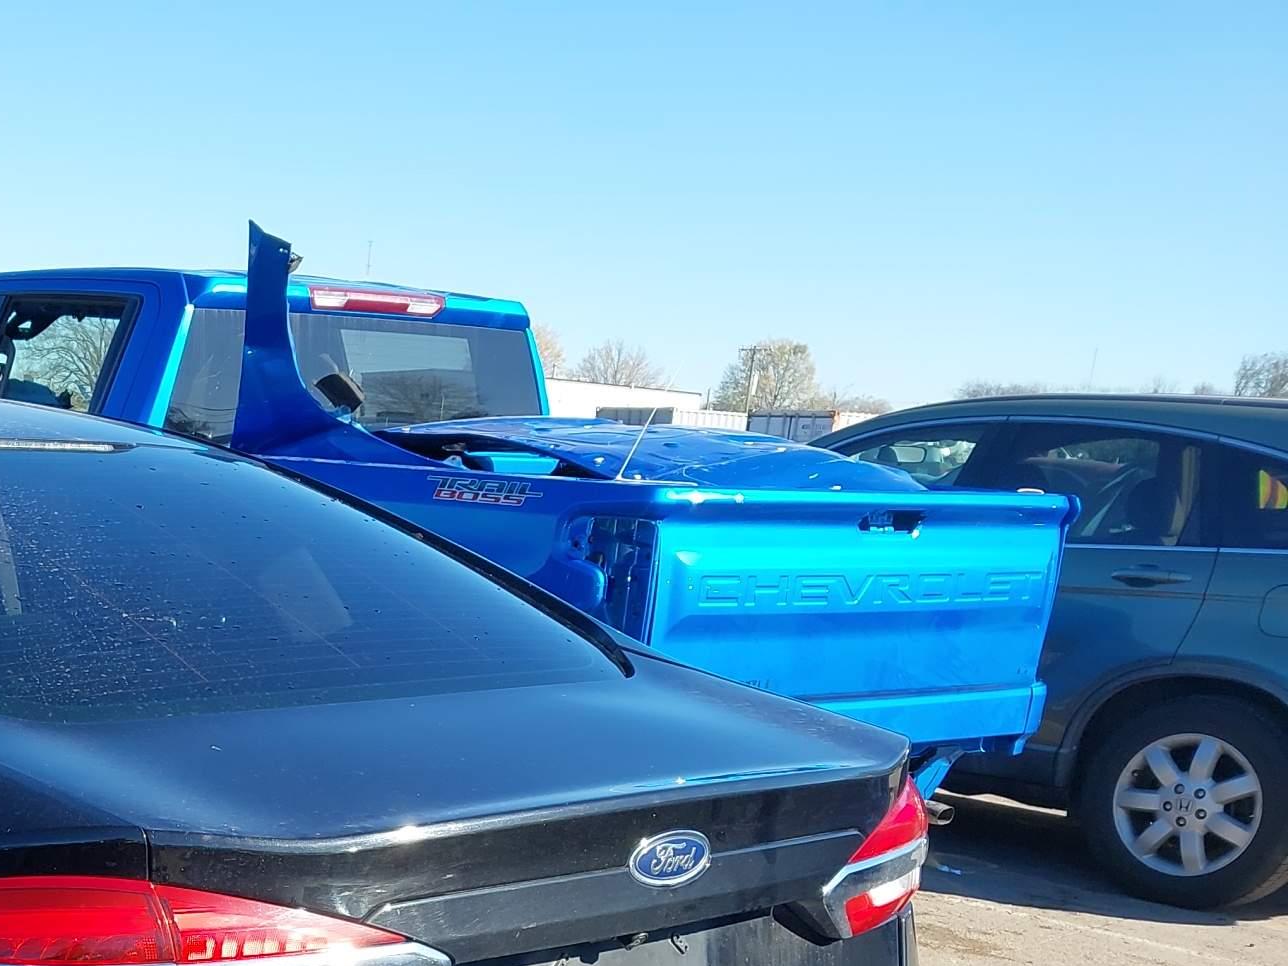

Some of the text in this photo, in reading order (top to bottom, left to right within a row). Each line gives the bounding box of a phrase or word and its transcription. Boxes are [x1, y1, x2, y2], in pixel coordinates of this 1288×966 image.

[427, 475, 544, 498] TRAIL
[432, 488, 527, 507] BOSS
[697, 571, 1043, 608] CHEVROLET
[650, 842, 696, 875] Ford
